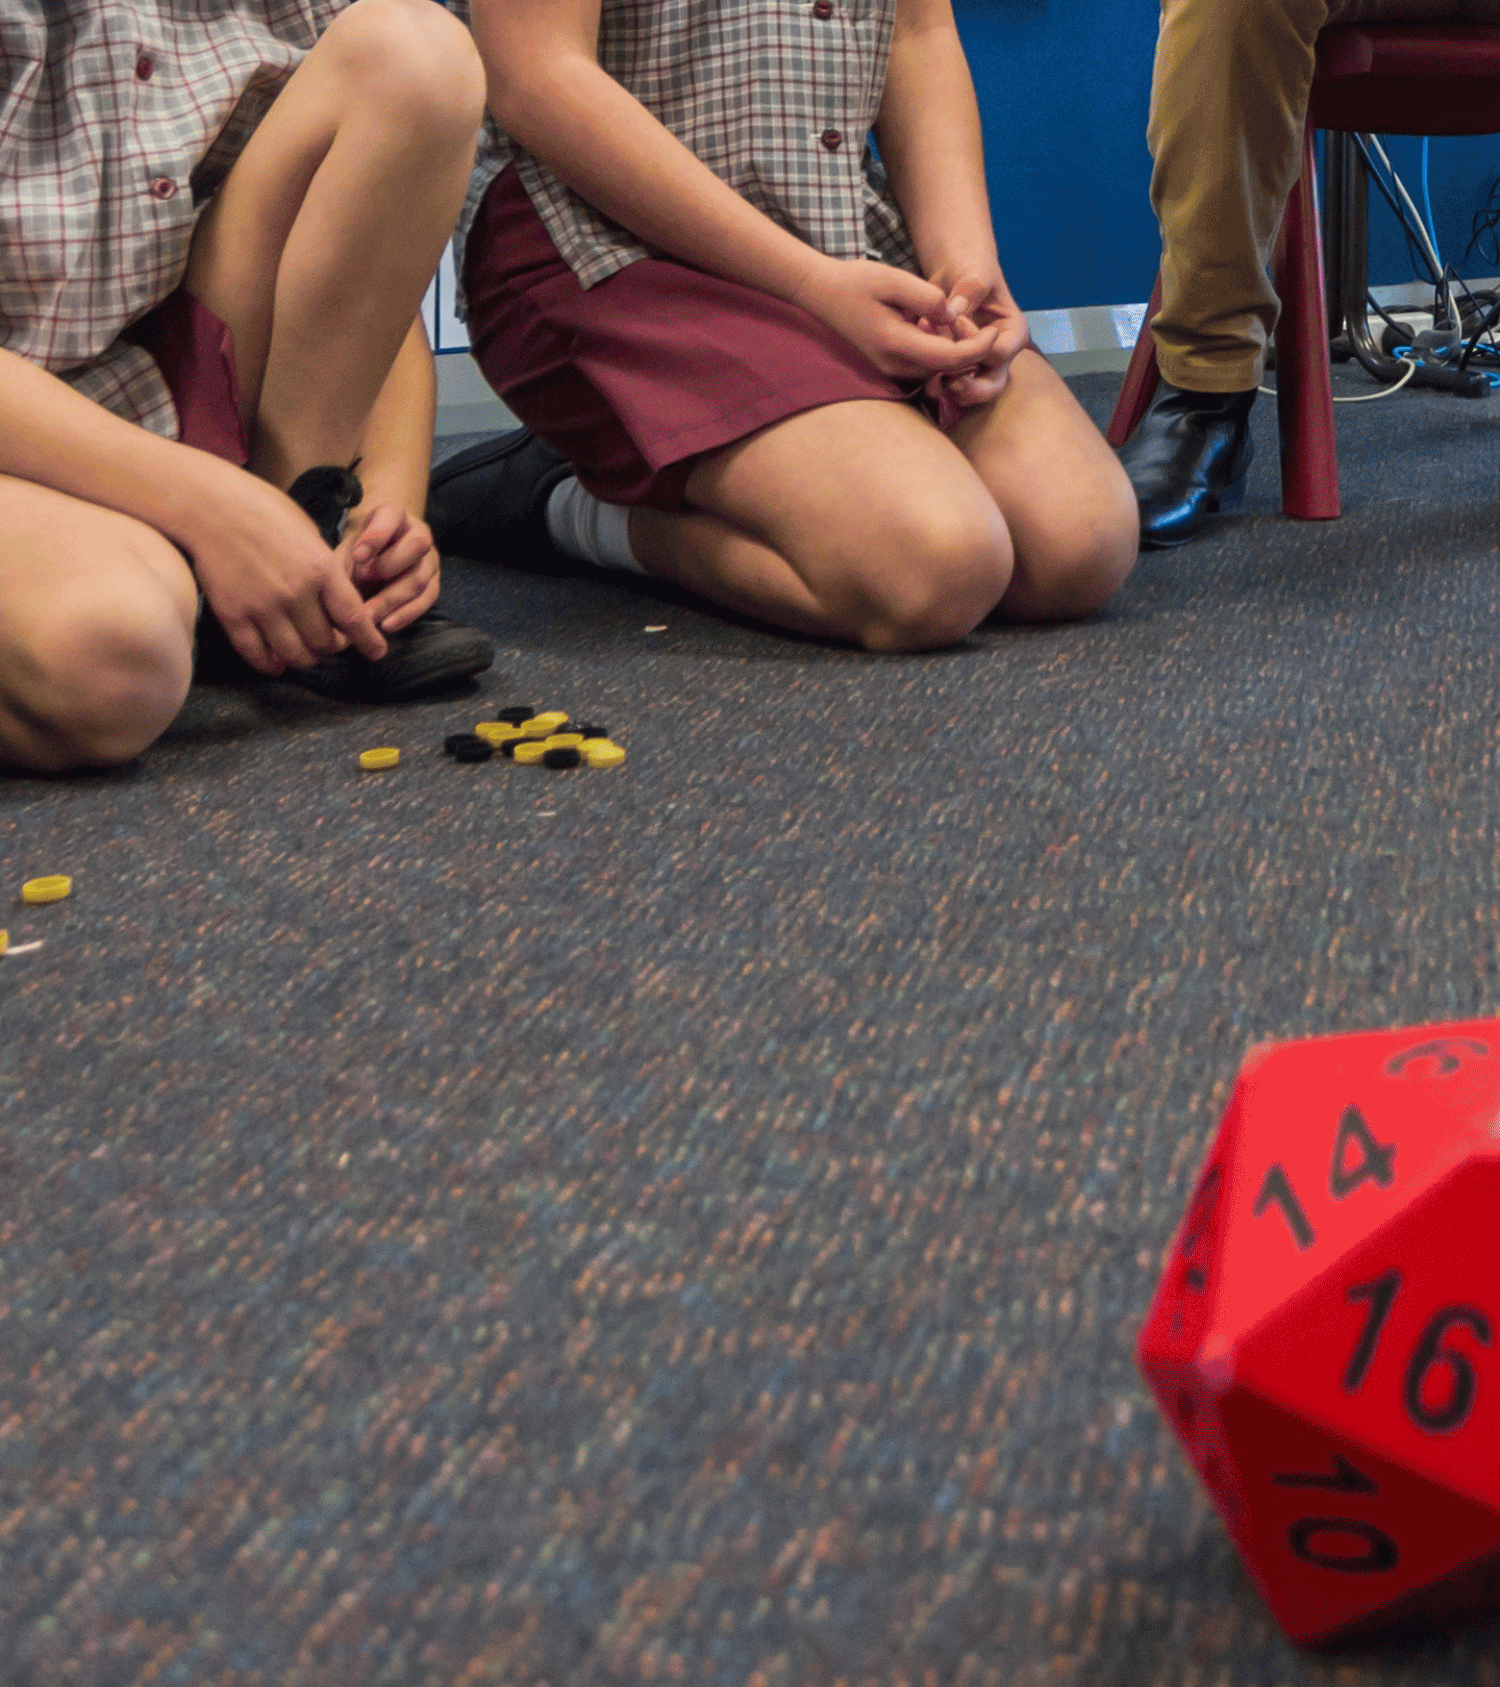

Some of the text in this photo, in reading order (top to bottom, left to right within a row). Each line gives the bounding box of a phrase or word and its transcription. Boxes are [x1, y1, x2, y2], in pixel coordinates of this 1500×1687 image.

[1252, 1102, 1397, 1250] 14
[1346, 1269, 1493, 1433] 16
[1272, 1453, 1400, 1576] 10
